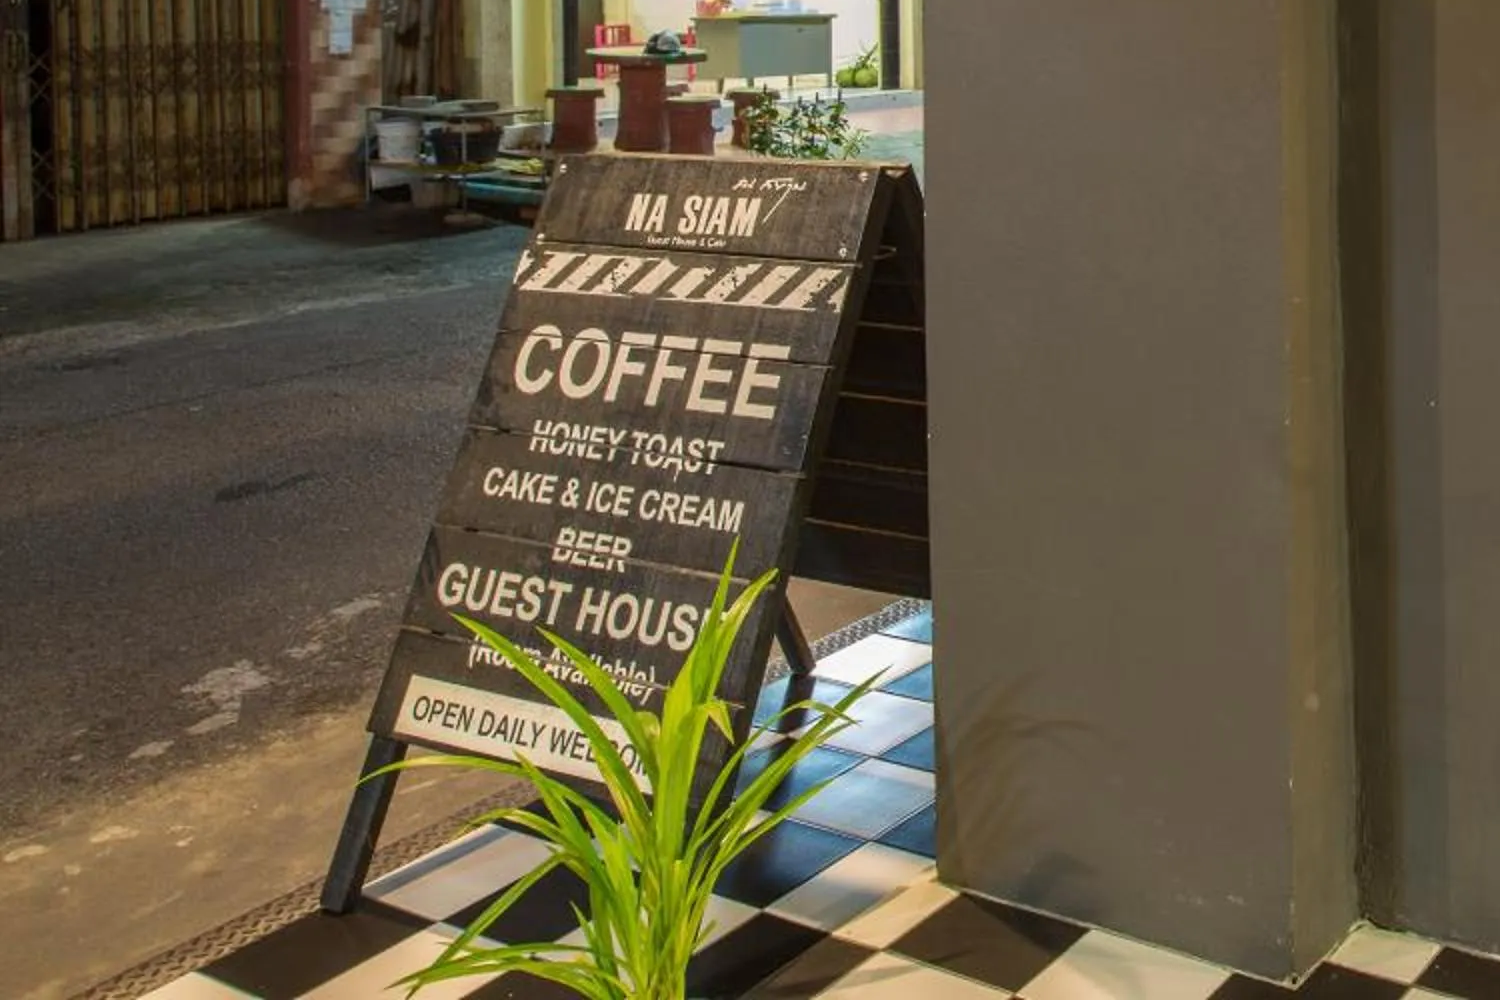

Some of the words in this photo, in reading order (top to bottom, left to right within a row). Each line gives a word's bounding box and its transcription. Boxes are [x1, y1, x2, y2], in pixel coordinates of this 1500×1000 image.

[625, 193, 668, 233] NA
[677, 195, 762, 237] SIAM
[513, 324, 791, 420] COFFEE
[529, 419, 628, 463] HONEY
[630, 430, 725, 475] TOAST
[483, 466, 559, 505] CAKE
[559, 477, 580, 510] &
[585, 480, 635, 517] ICE
[639, 489, 745, 534] CREAM
[552, 526, 633, 573] BEER
[438, 563, 573, 626] GUEST
[575, 586, 730, 652] HOUS
[412, 695, 475, 733] OPEN
[477, 711, 547, 749] DAILY
